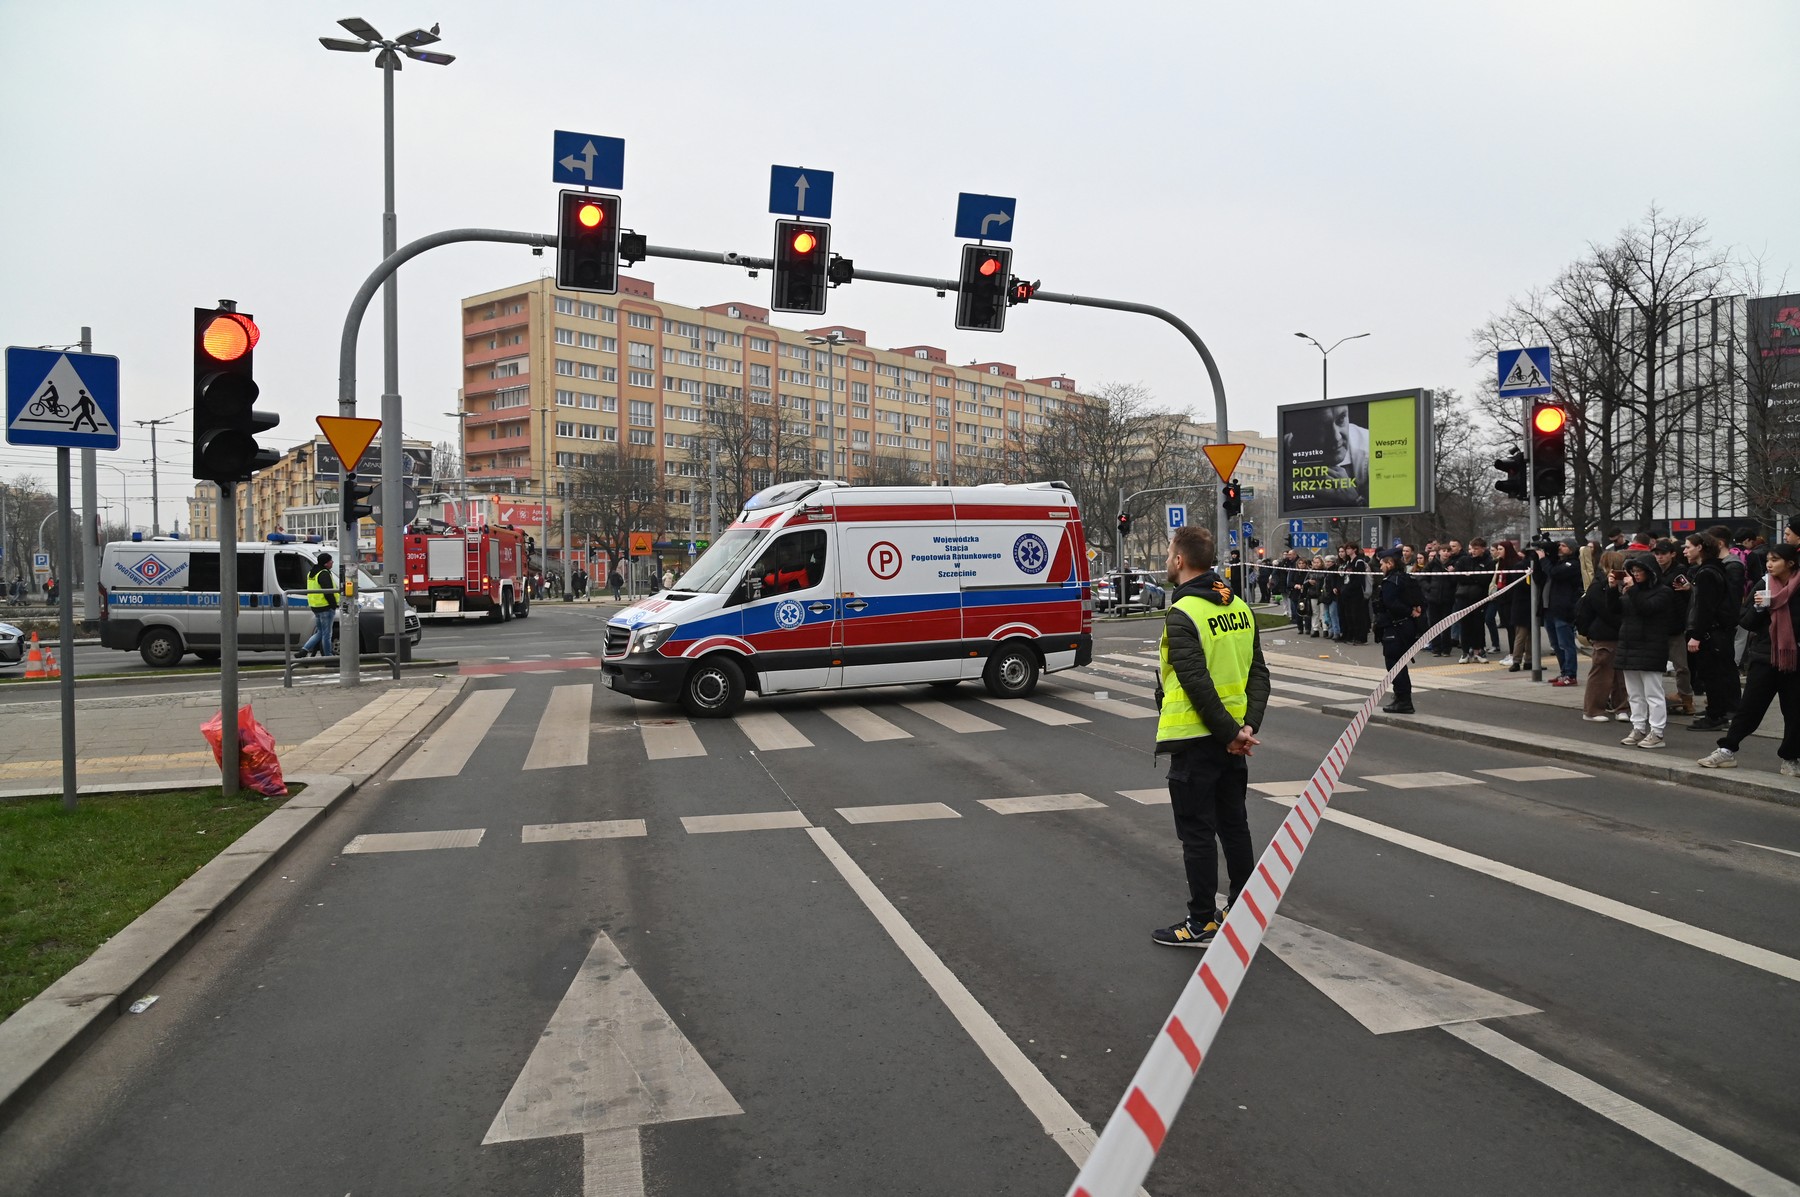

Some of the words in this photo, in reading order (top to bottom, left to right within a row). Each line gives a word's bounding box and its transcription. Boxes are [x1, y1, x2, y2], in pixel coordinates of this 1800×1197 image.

[1375, 437, 1408, 447] Wesprzyj
[1292, 449, 1324, 458] wszystko
[1292, 465, 1329, 479] PIOTR
[1292, 477, 1357, 492] KRZYSTEK
[1172, 509, 1181, 524] P
[933, 536, 979, 544] Wojewódzka
[879, 550, 893, 572] P
[911, 554, 951, 562] Pogotowia
[952, 553, 1001, 561] Ratunkowego
[114, 562, 143, 585] POGOTOWIE
[146, 564, 155, 574] R
[156, 561, 189, 586] WYPADKOWE
[938, 570, 977, 578] Szczecinie
[118, 595, 144, 604] W180
[197, 596, 220, 605] POLI
